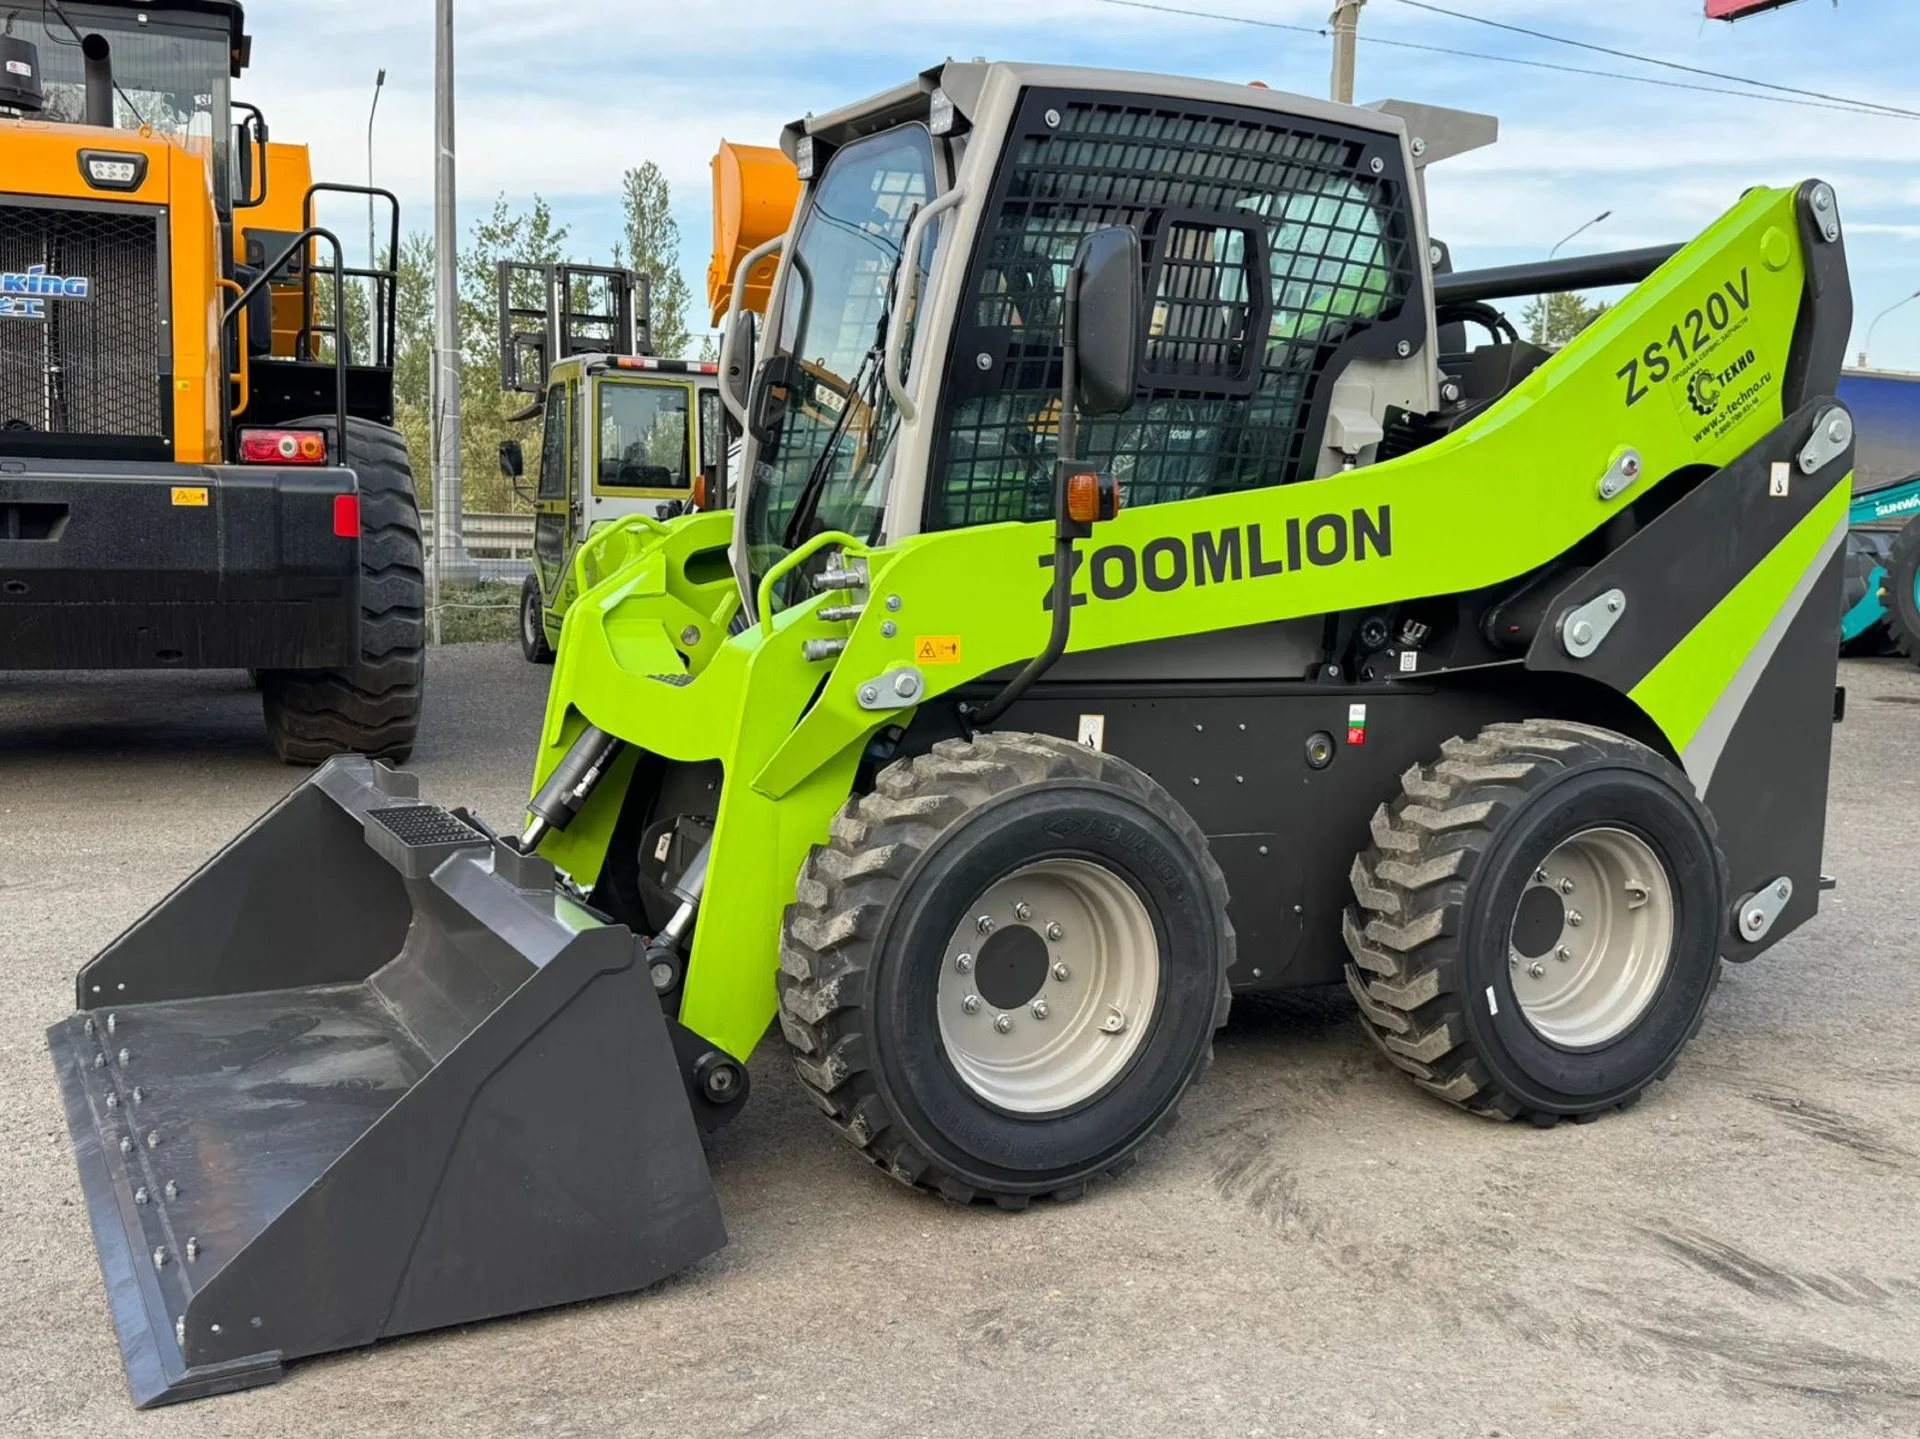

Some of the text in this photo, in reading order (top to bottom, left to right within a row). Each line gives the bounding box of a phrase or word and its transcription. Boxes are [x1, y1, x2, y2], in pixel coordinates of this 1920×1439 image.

[0, 264, 88, 297] king
[1616, 267, 1749, 407] ZS120V
[1698, 339, 1722, 362] СЕРВИС
[1715, 349, 1756, 388] ТЕХНО
[1692, 371, 1772, 443] www.s-techno.ru
[1038, 504, 1393, 611] ZOOMLION
